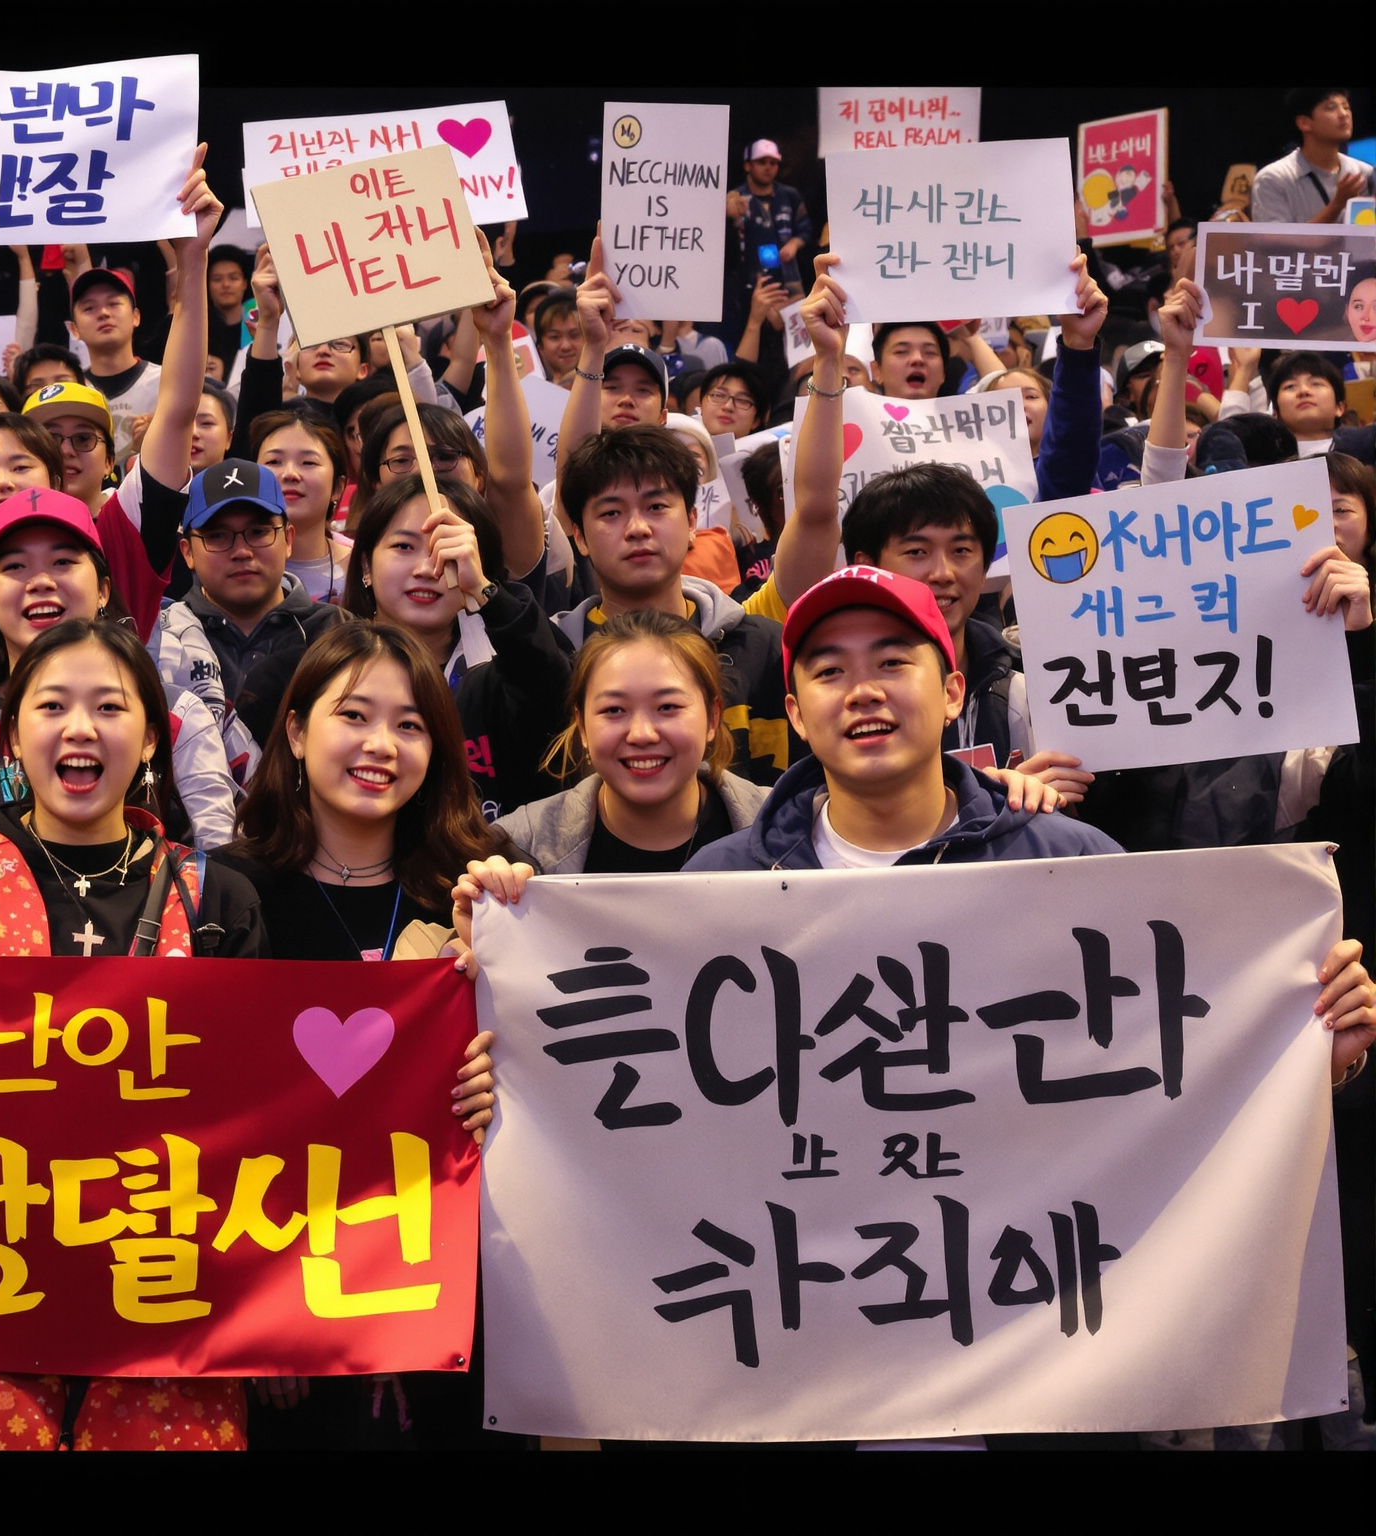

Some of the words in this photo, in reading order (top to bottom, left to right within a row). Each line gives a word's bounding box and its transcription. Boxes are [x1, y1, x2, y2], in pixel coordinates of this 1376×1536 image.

[647, 195, 669, 217] IS
[615, 262, 680, 290] YOUR
[1237, 302, 1265, 329] I
